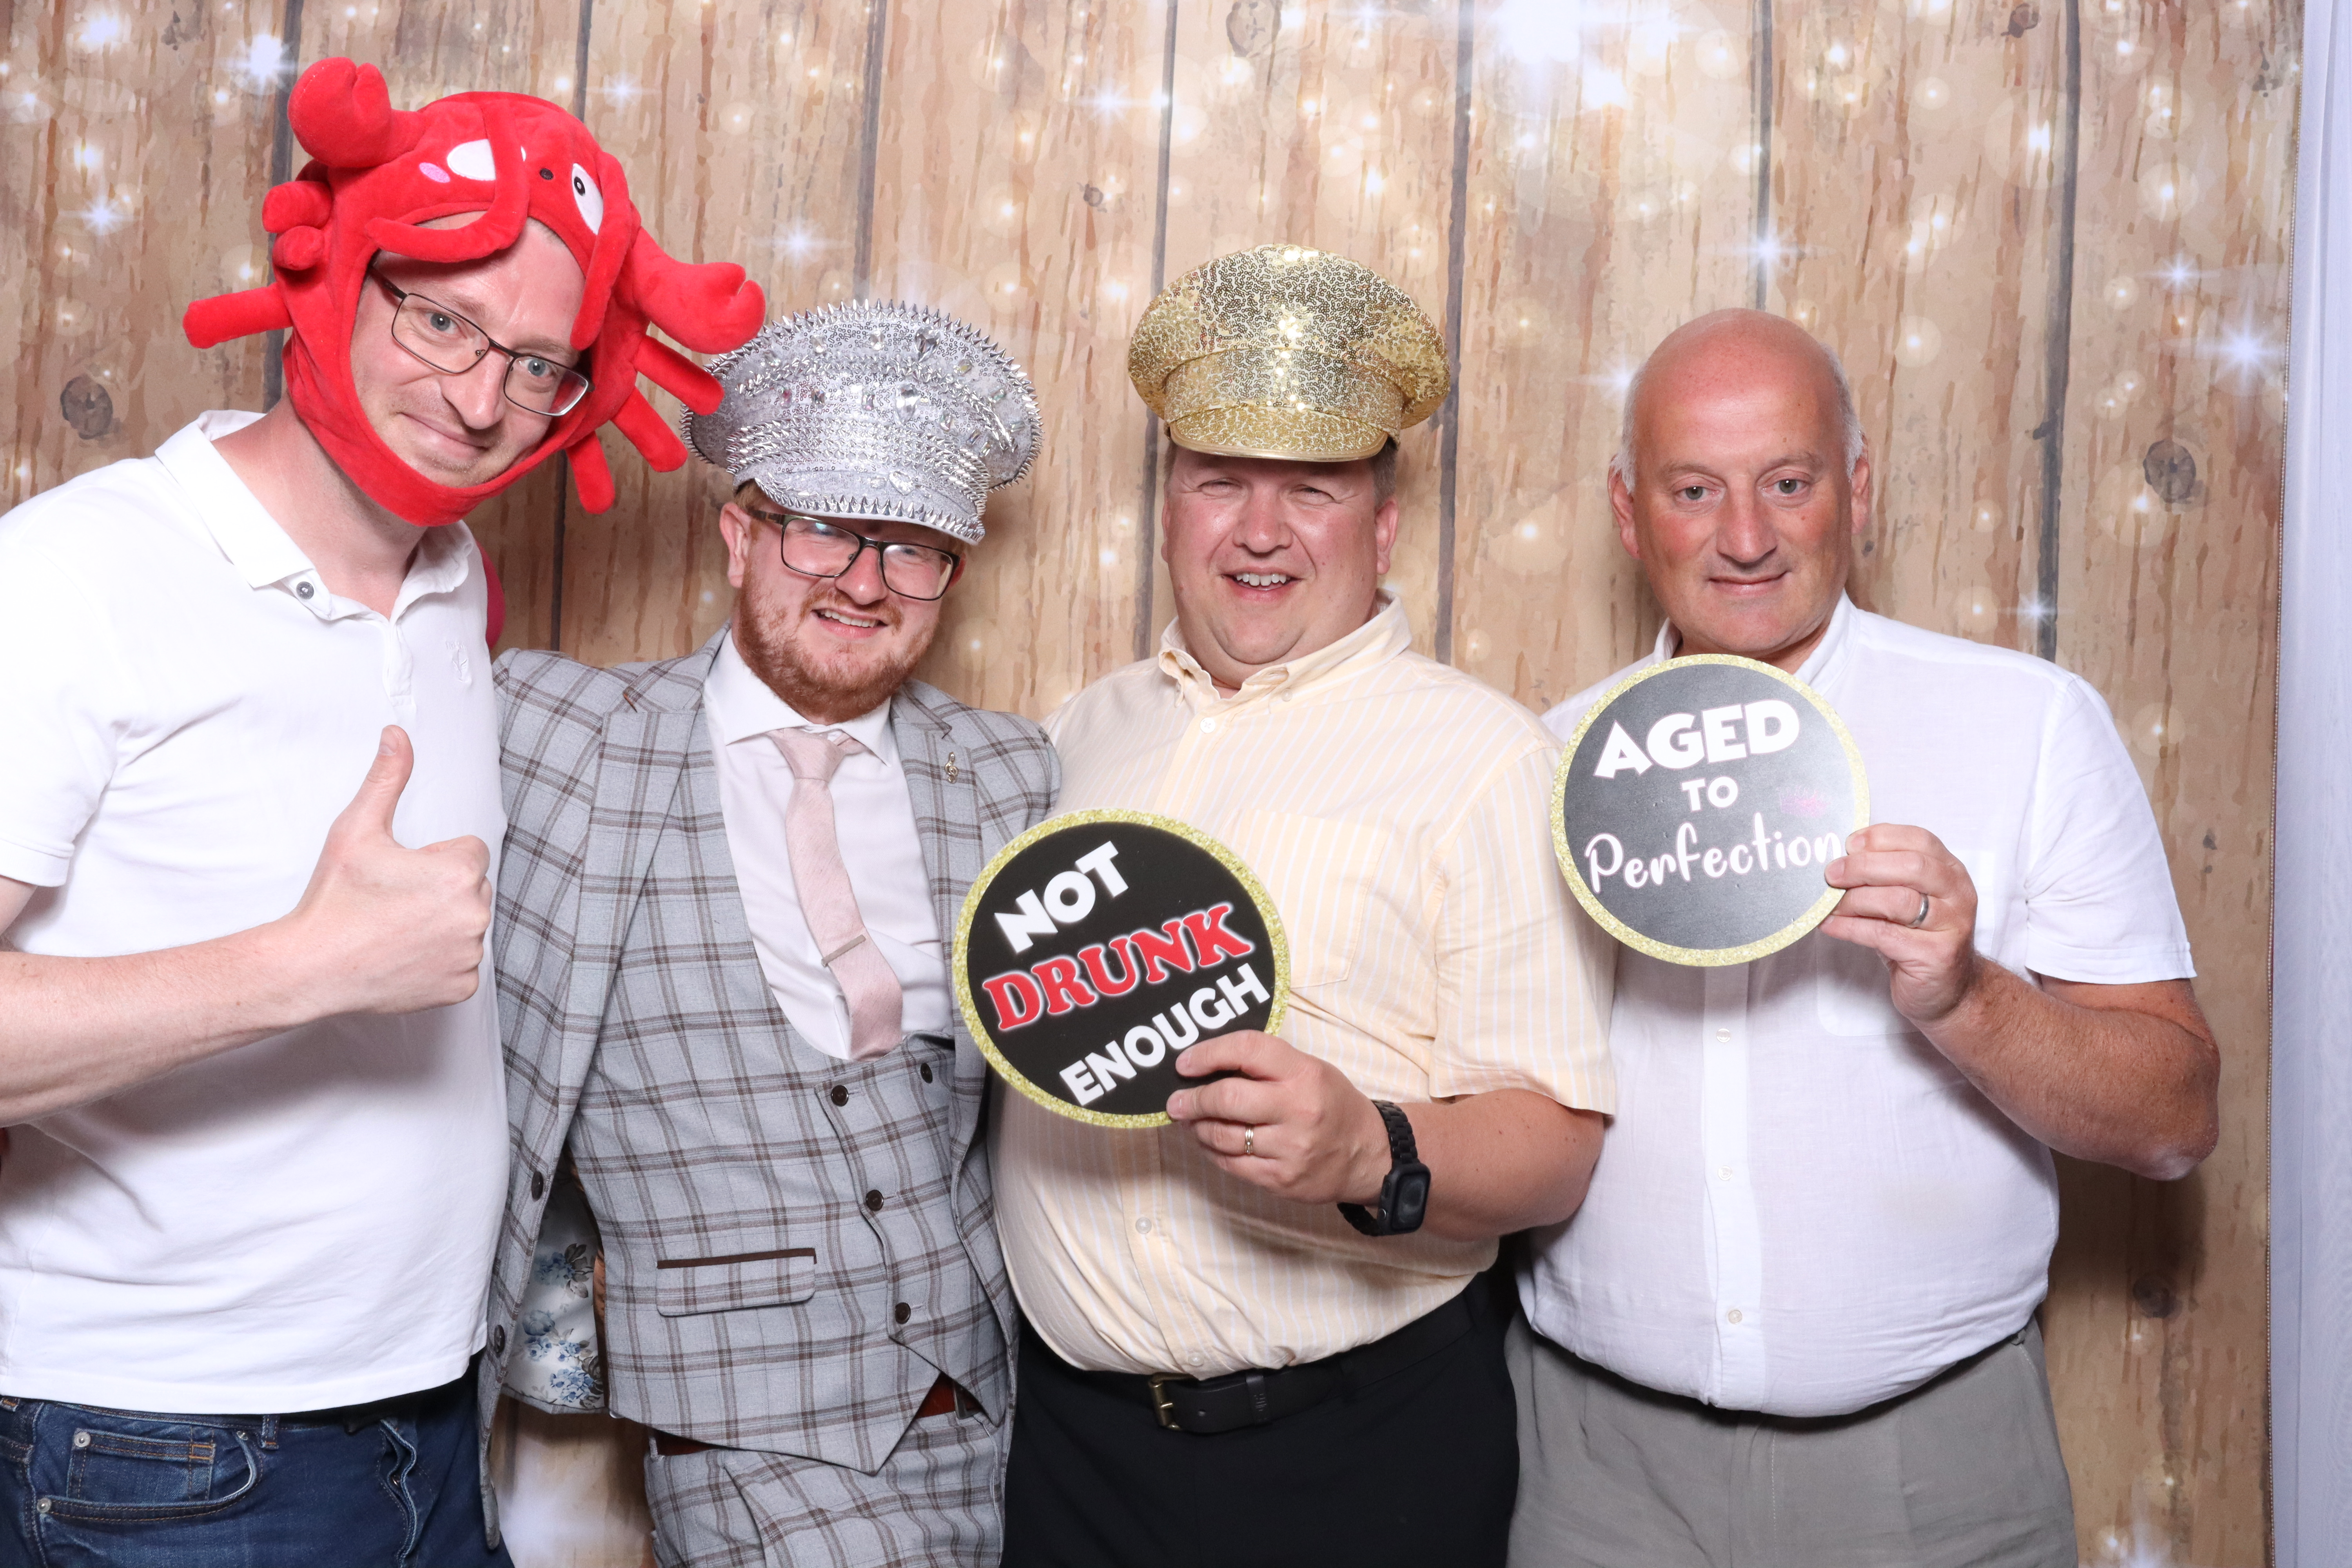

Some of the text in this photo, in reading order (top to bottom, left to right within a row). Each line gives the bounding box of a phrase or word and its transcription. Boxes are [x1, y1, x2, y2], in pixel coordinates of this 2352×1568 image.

[1594, 699, 1800, 779] AGED
[1681, 776, 1739, 812] TO
[994, 840, 1129, 953] NOT
[1584, 812, 1842, 893] Perfection
[982, 902, 1255, 1032] DRUNK
[1059, 963, 1270, 1107] ENOUGH
